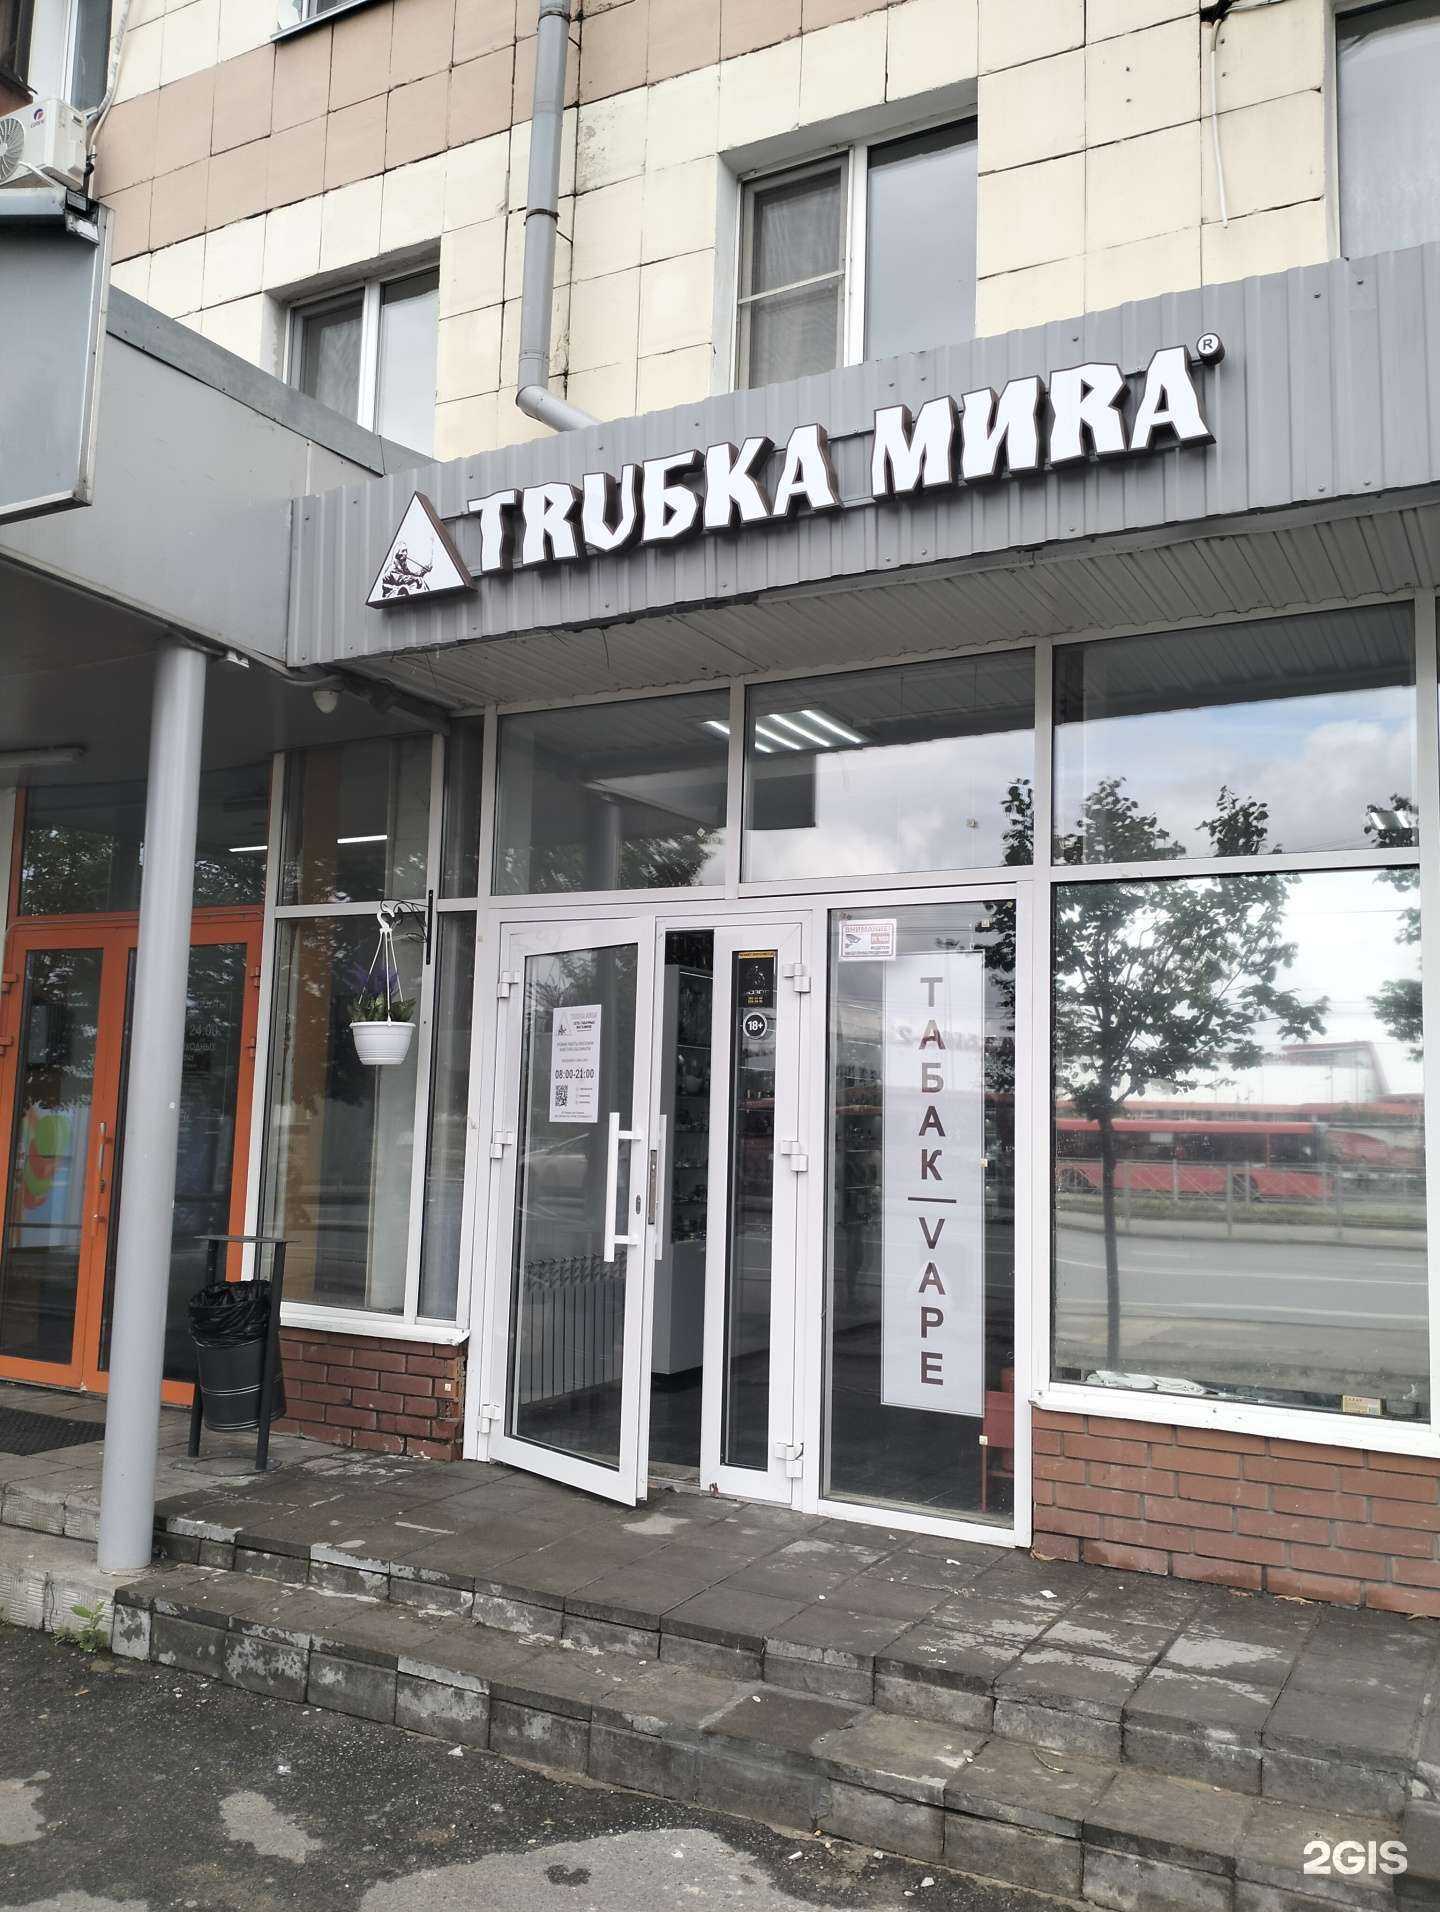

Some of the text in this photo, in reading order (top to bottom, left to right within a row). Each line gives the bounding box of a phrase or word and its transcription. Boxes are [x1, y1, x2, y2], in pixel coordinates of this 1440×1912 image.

[747, 1020, 764, 1031] 18+
[918, 976, 945, 1181] ТАБАК
[919, 1217, 945, 1386] VAPE
